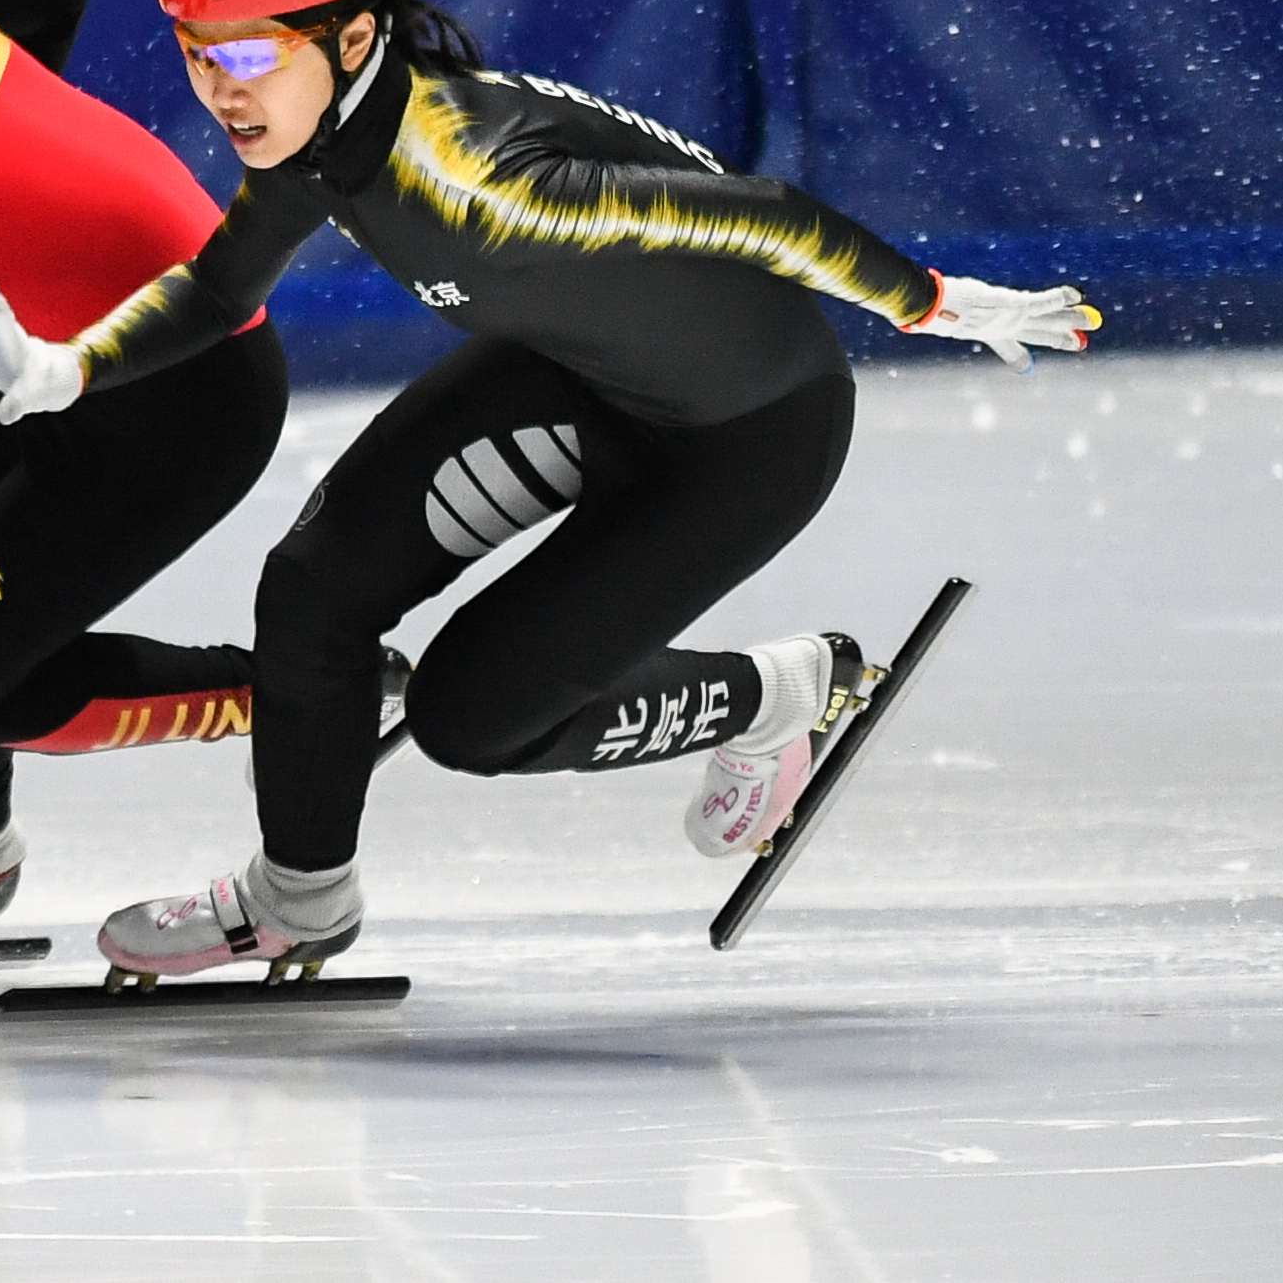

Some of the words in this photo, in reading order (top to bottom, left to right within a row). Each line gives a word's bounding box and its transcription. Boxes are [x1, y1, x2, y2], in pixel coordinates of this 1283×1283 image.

[521, 73, 725, 175] BEIJING
[413, 280, 470, 308] 北京
[162, 696, 252, 742] LIN
[591, 680, 730, 762] 北京市
[812, 685, 850, 734] Feel
[722, 812, 754, 844] BEST
